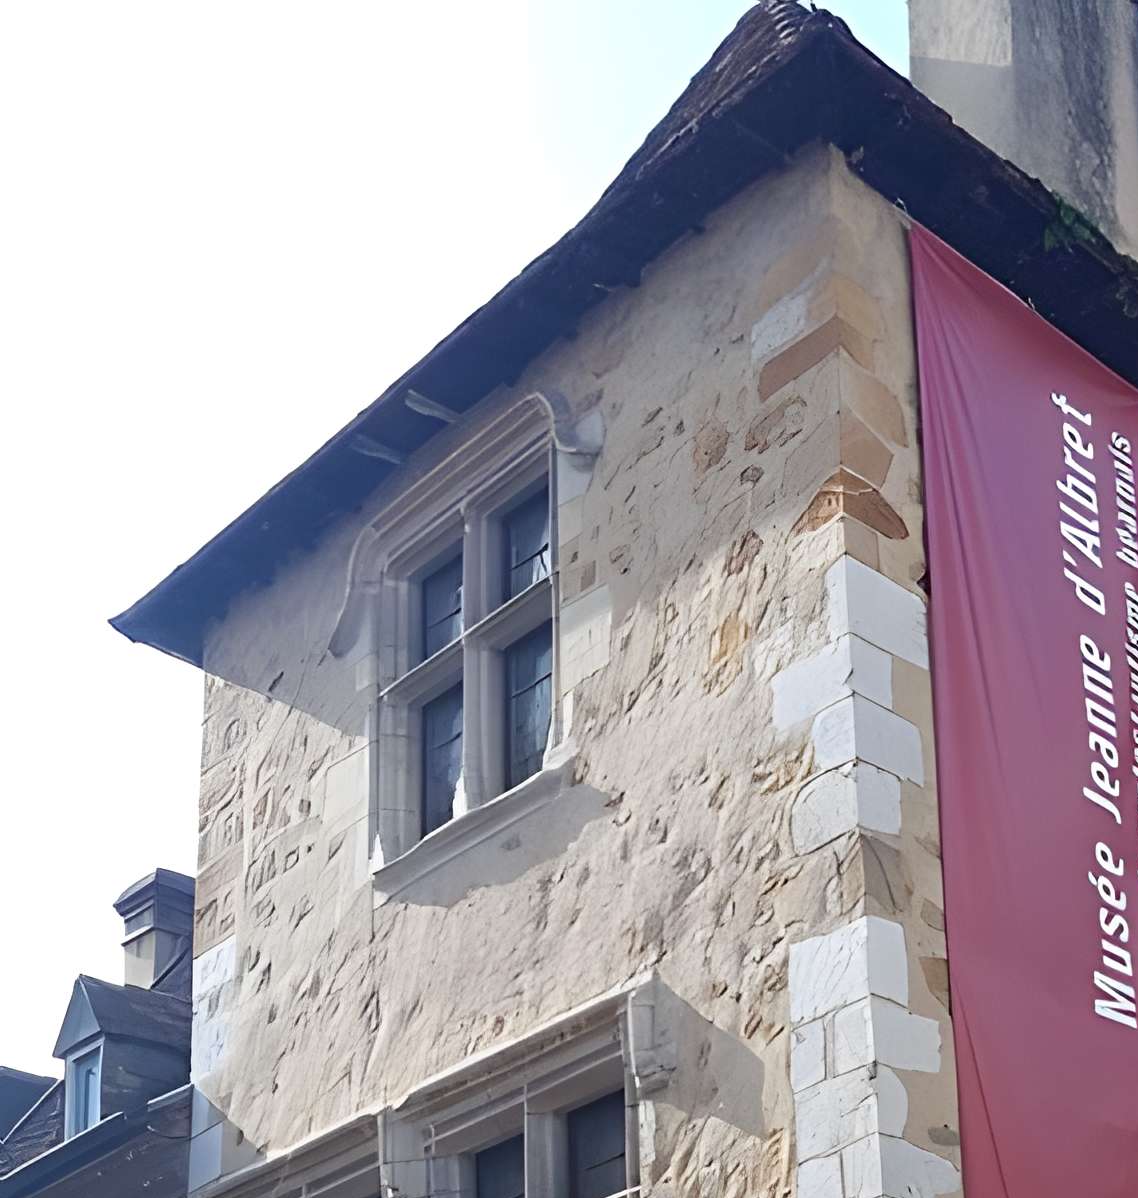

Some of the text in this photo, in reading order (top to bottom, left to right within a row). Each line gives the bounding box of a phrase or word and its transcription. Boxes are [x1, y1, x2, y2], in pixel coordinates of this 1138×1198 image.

[1050, 391, 1138, 1030] Musée Jeanne d'Albret
